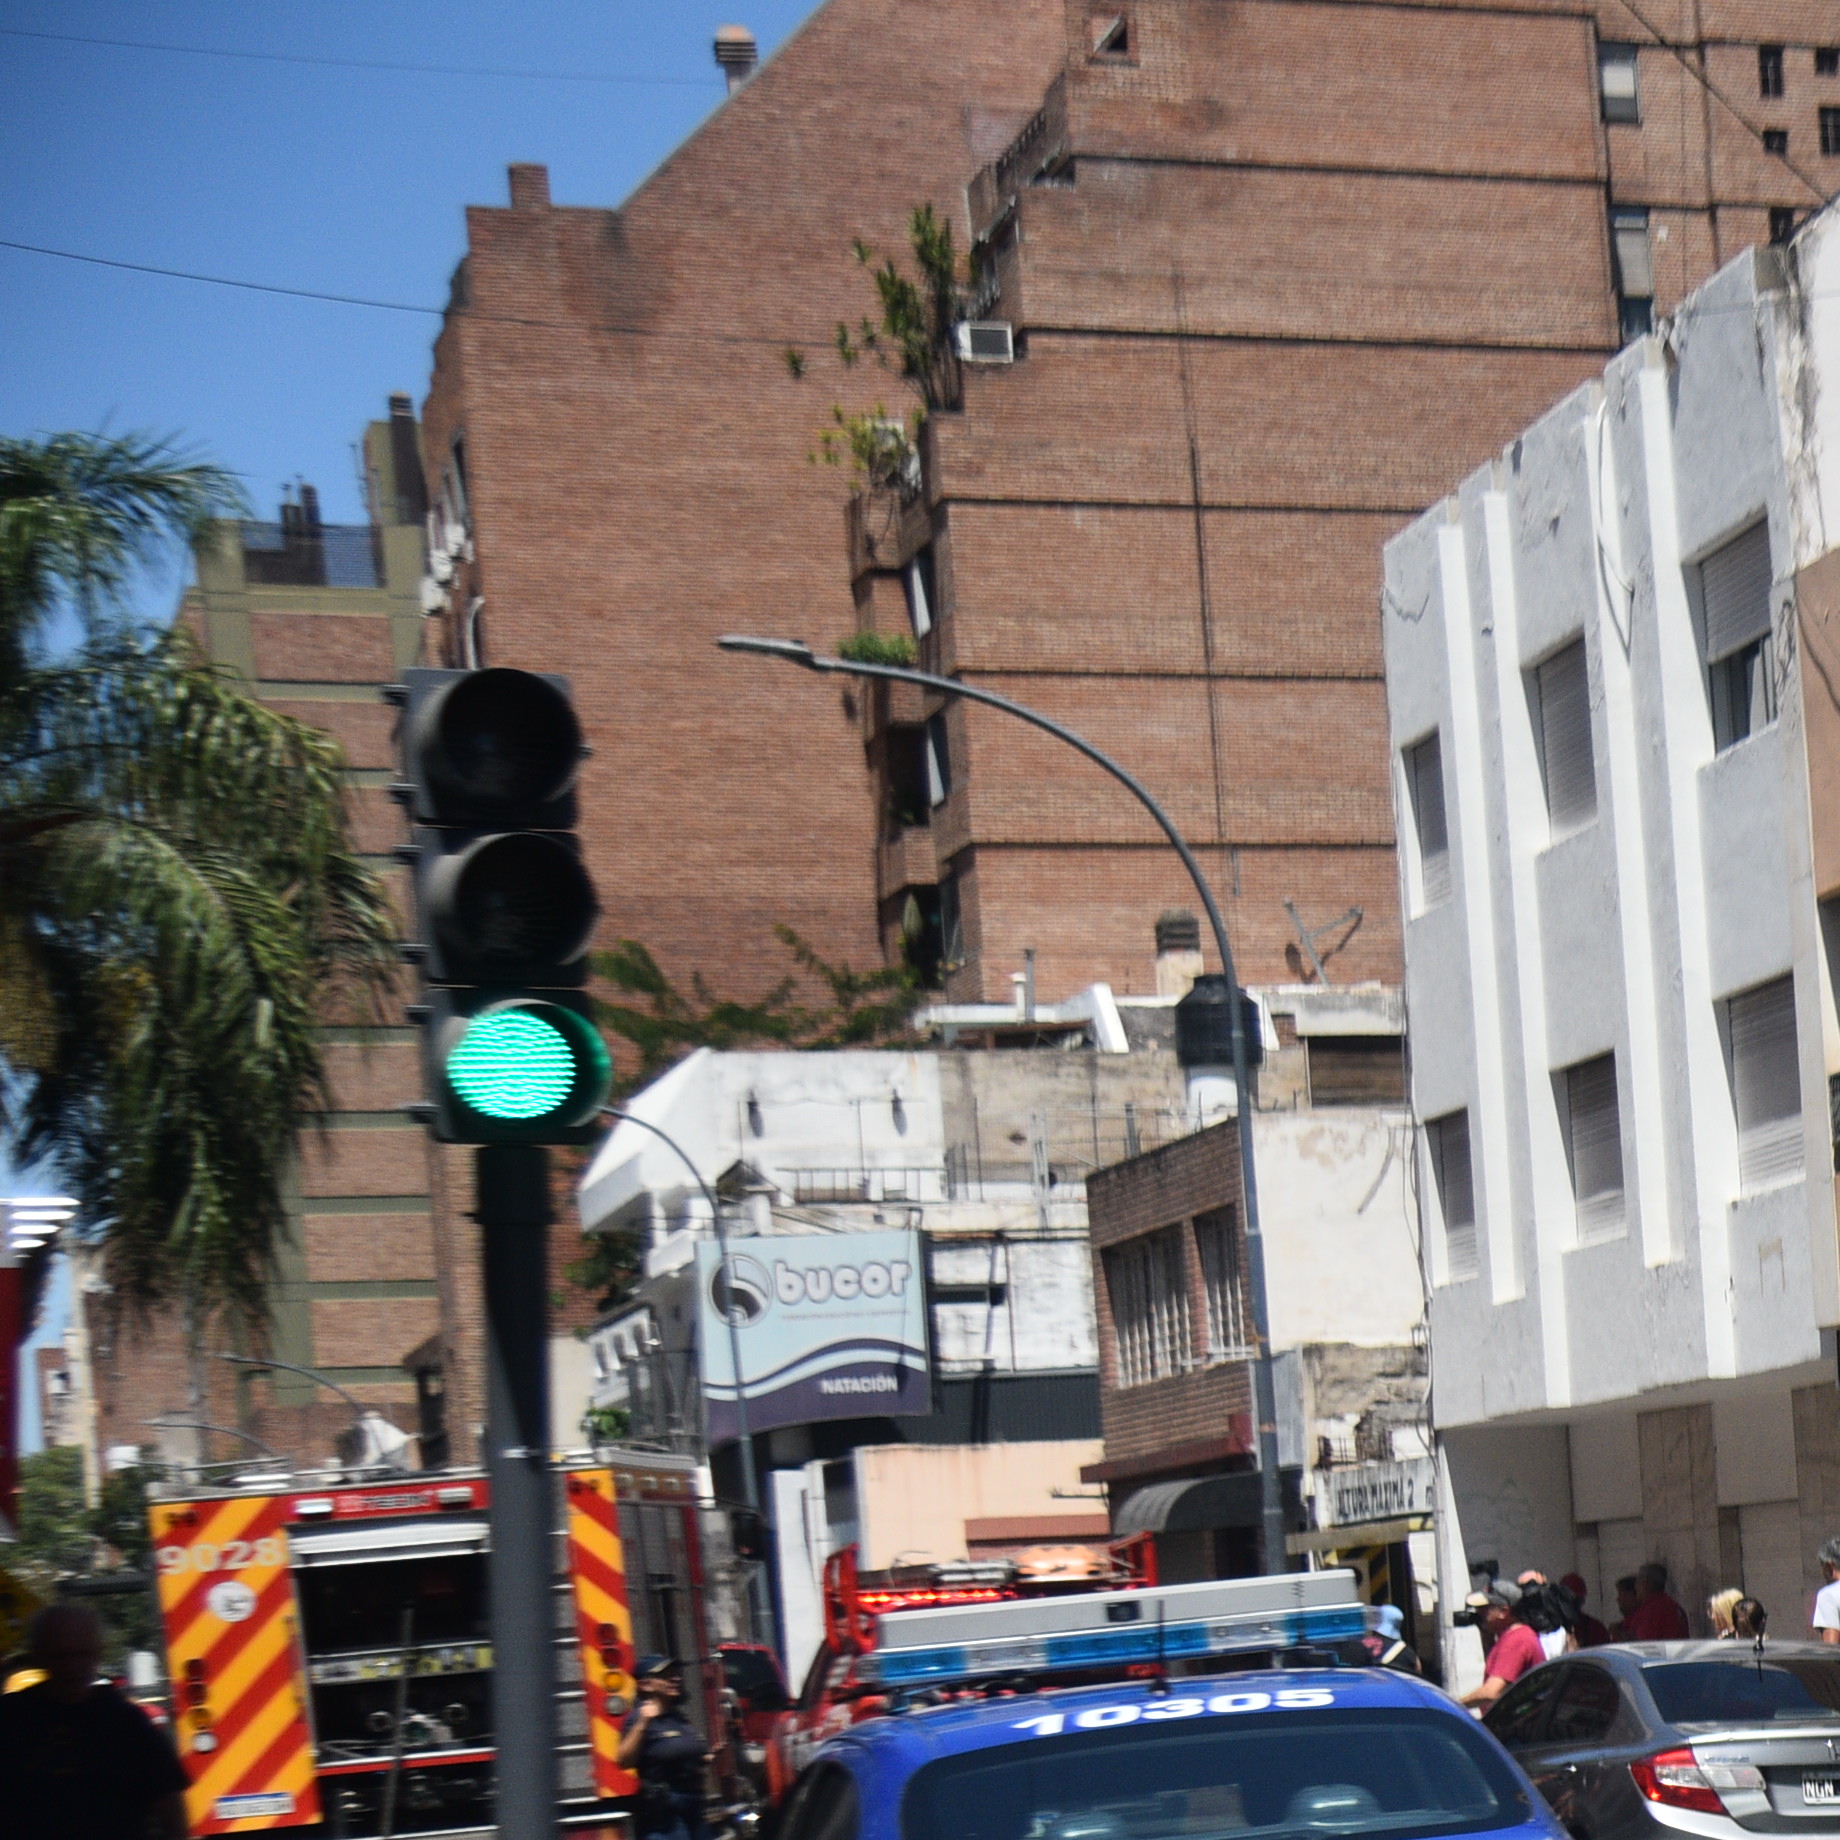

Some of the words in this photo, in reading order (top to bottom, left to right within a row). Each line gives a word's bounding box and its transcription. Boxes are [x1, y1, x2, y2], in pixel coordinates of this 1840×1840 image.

[775, 1258, 912, 1306] bucor
[820, 1374, 898, 1395] NATACIÓN
[156, 1537, 281, 1575] 9028
[1010, 1688, 1335, 1736] 10305
